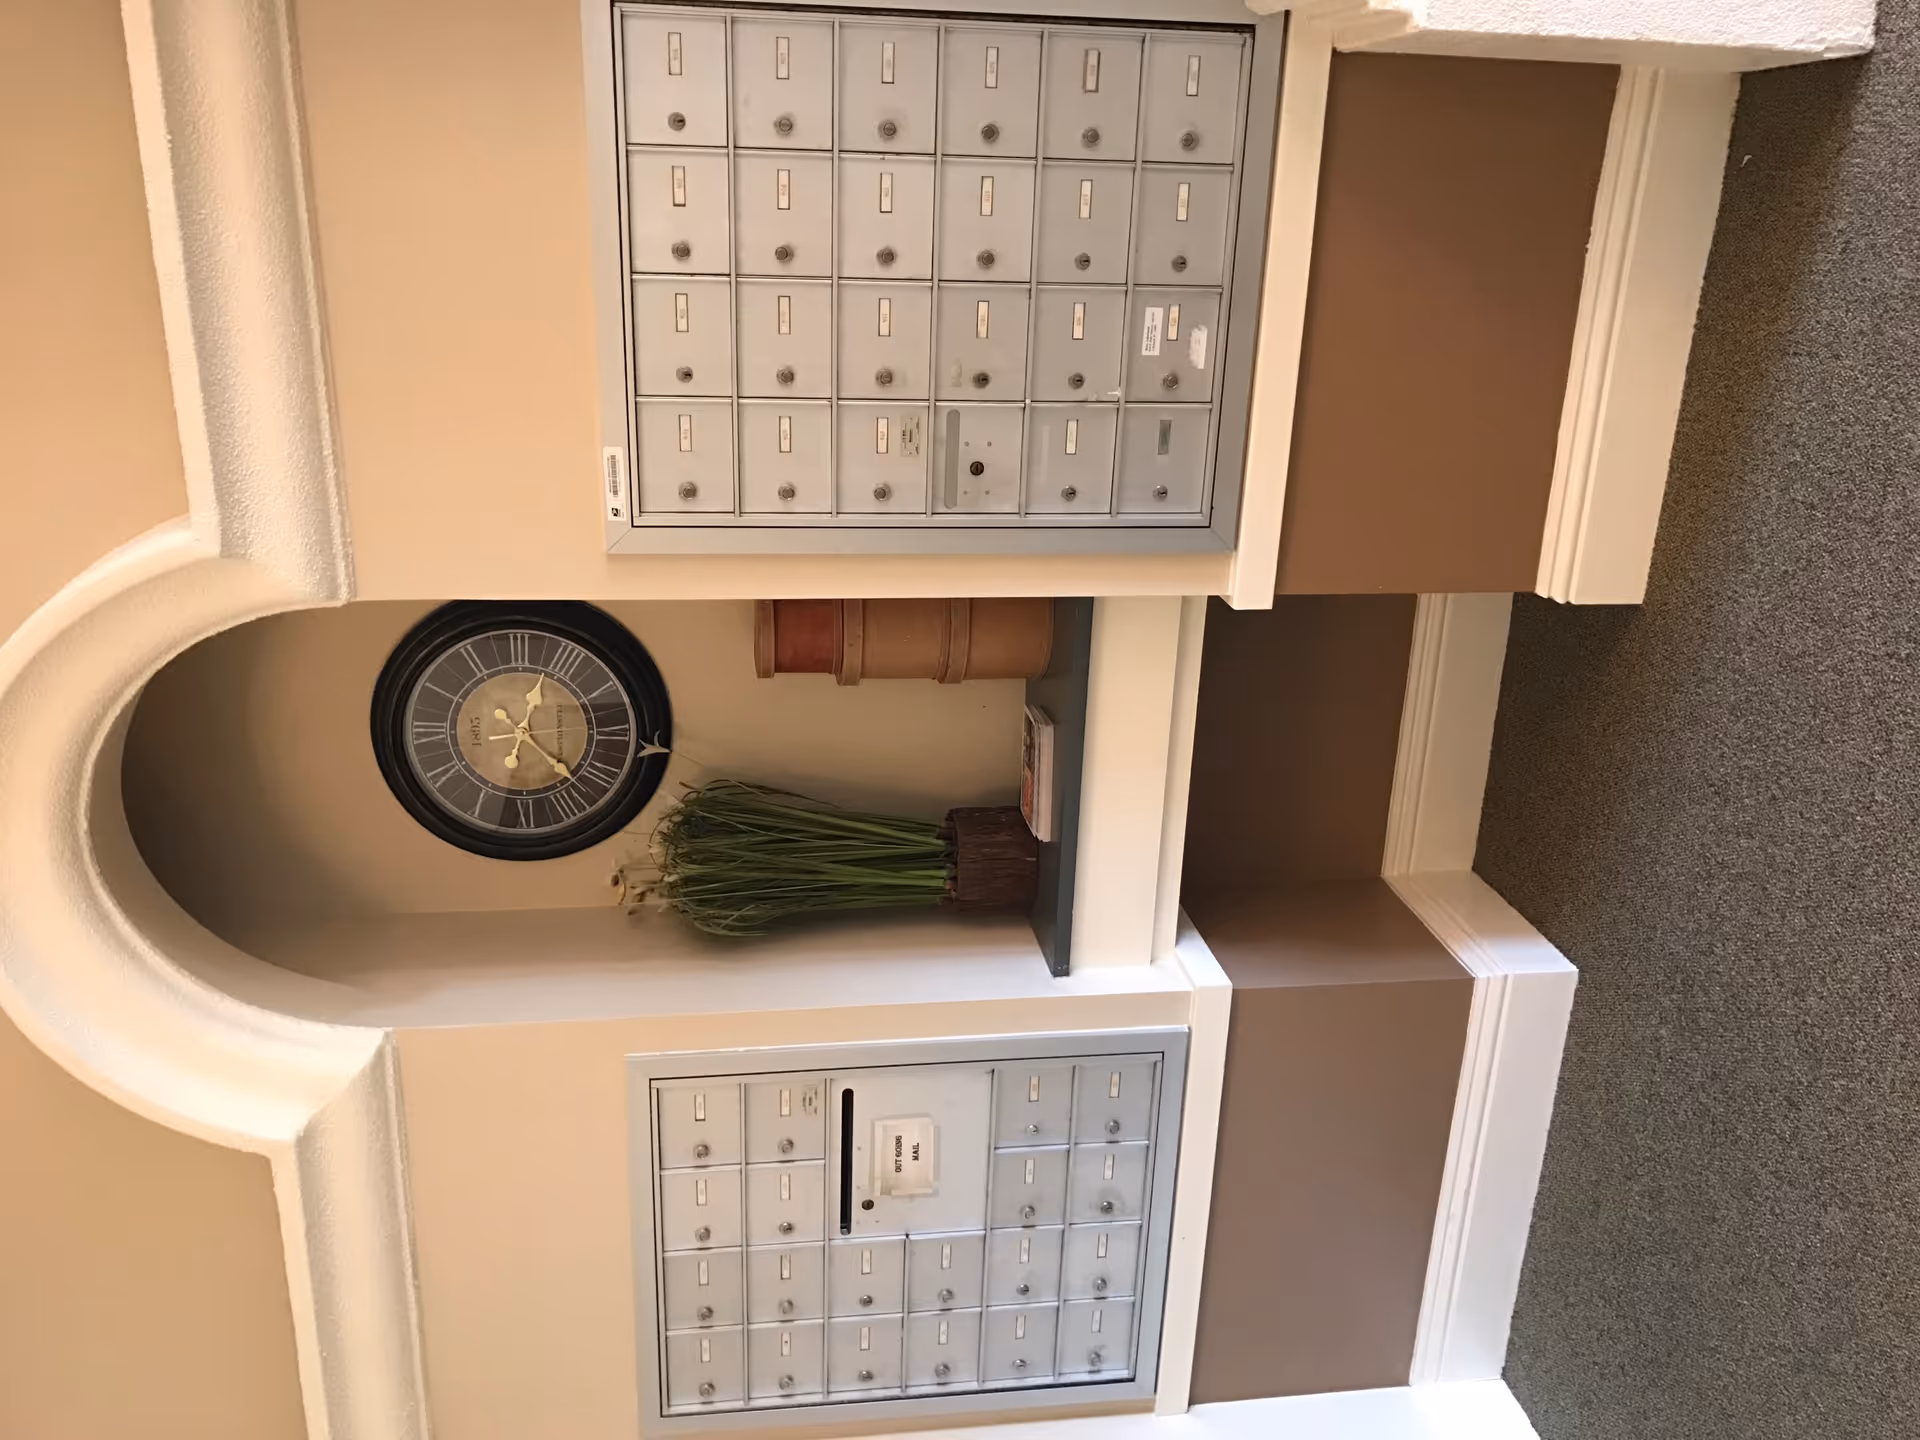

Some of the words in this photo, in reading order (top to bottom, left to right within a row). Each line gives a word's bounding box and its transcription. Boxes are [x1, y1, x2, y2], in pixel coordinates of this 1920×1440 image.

[894, 1135, 903, 1158] GOING
[911, 1142, 920, 1161] MAIL
[894, 1159, 903, 1173] OUT
